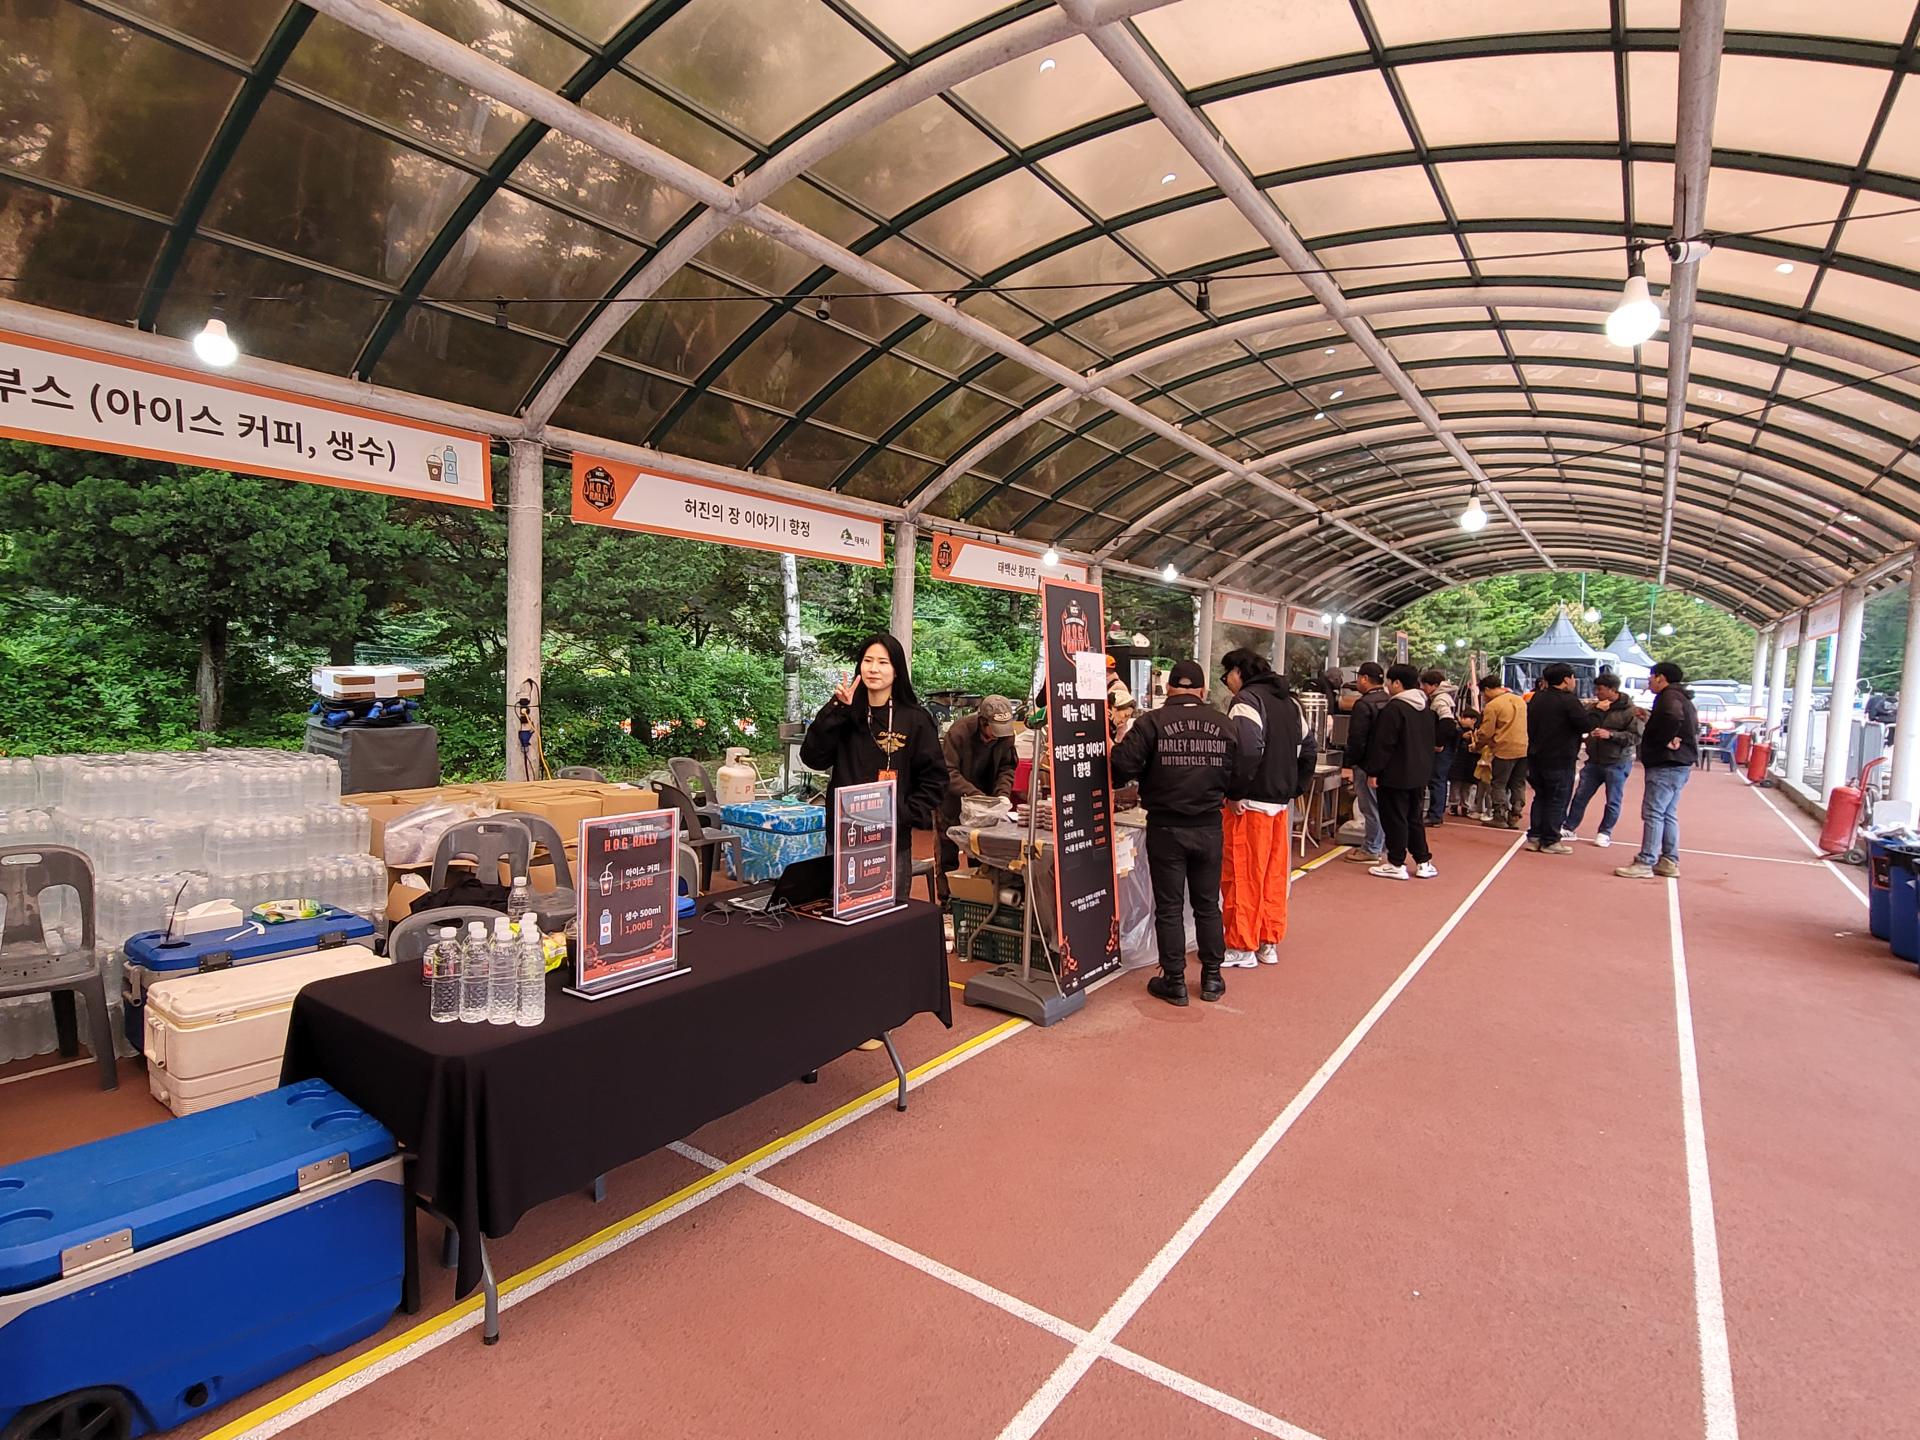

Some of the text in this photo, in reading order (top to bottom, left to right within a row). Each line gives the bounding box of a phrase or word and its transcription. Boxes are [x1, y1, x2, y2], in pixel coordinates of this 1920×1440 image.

[0, 368, 396, 472] 부스 (아이스 커피, 생수)
[684, 499, 723, 522] 허진의
[728, 508, 740, 524] 장
[745, 511, 779, 532] 이야기
[1057, 682, 1073, 700] 지역
[1062, 703, 1096, 722] 메뉴 안내
[1055, 740, 1105, 761] 허진의 장 이야기
[632, 832, 658, 848] RALLY
[626, 863, 660, 877] 아이스 커피
[626, 875, 654, 890] 3,500원
[625, 905, 661, 921] 생수 500ml
[625, 919, 653, 935] 1,000원
